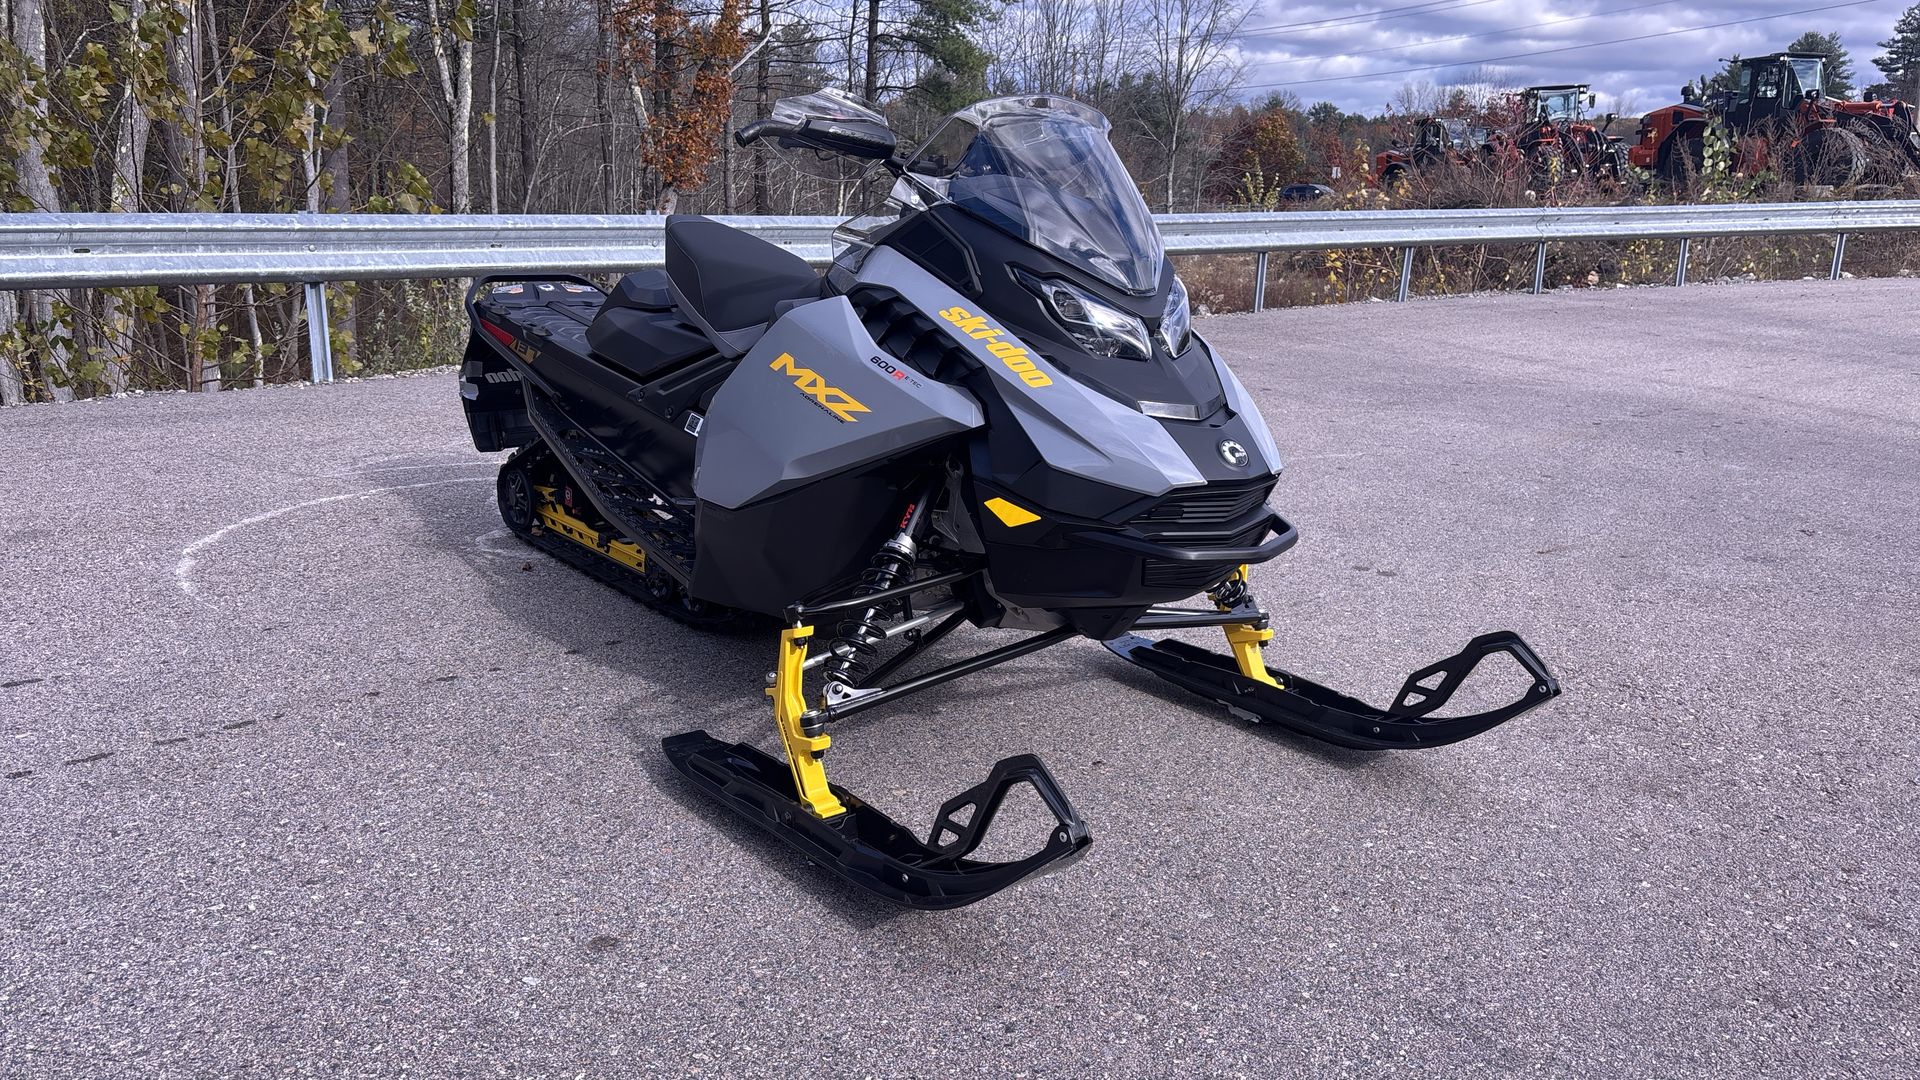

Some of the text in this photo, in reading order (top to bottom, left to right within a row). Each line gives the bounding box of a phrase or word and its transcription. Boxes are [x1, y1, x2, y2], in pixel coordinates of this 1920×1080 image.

[870, 355, 905, 380] 600R
[938, 306, 1054, 388] ski-doo
[769, 352, 873, 423] MXZ
[799, 392, 845, 424] ADRENALINE
